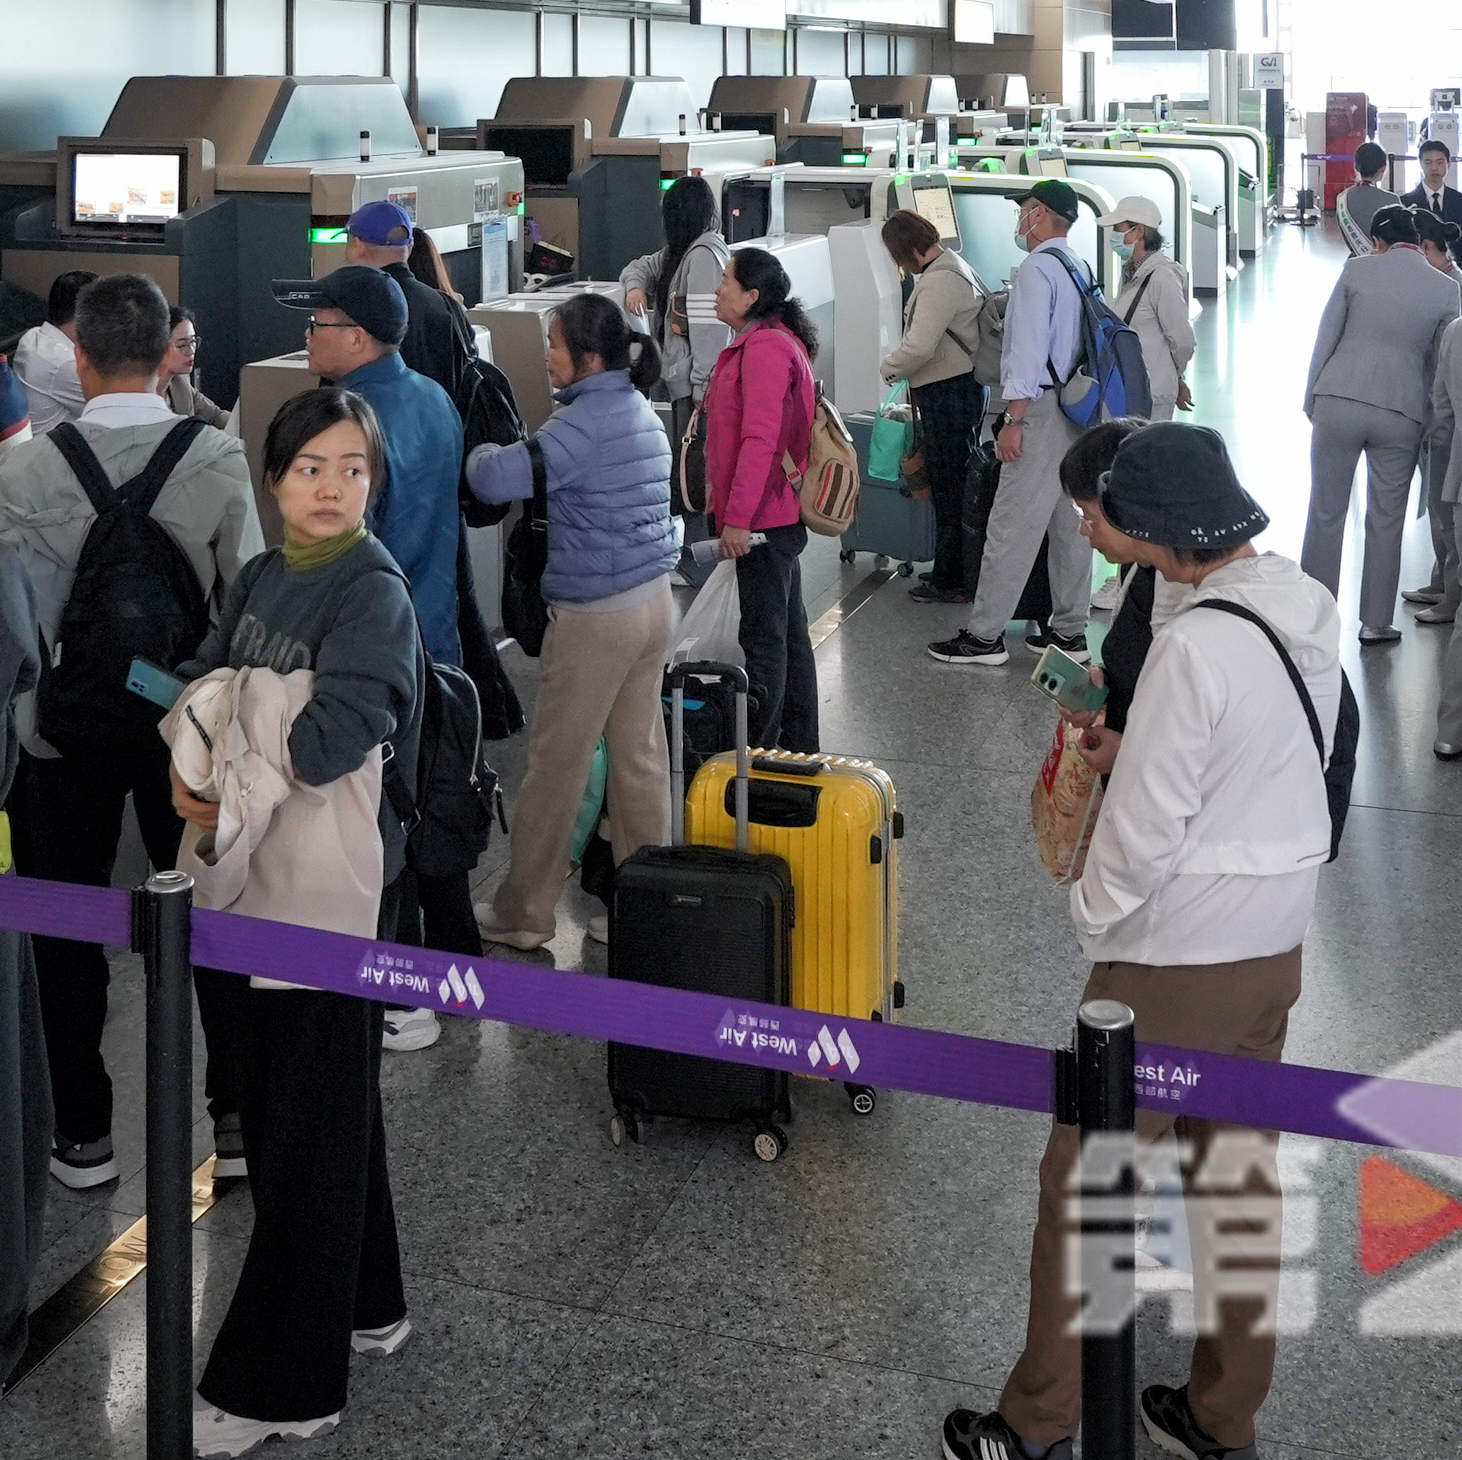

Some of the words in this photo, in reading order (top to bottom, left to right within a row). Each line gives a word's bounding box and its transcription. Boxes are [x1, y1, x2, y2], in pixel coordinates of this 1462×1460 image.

[361, 966, 384, 985] Air
[389, 971, 429, 994] West
[719, 1027, 747, 1047] Air
[751, 1032, 797, 1056] West
[1134, 1064, 1165, 1082] est
[1170, 1066, 1201, 1086] Air
